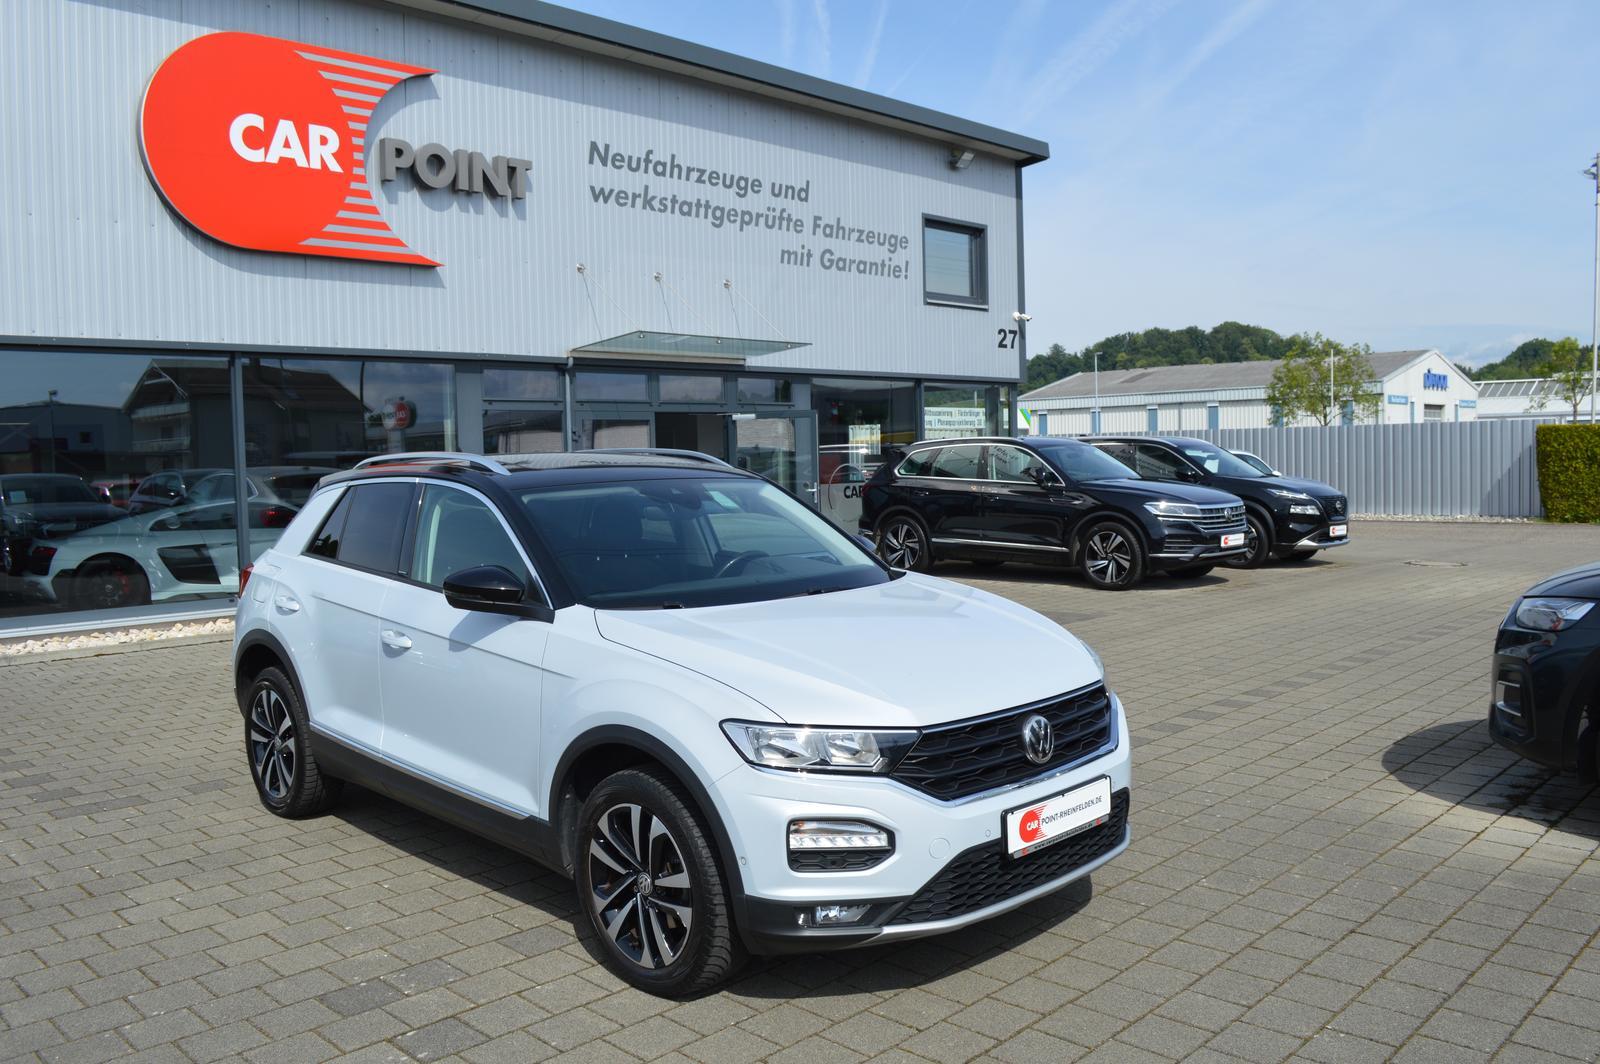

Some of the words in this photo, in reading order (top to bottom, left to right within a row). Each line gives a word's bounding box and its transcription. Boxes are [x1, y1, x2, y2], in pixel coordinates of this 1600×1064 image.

[229, 113, 343, 173] CAR
[380, 138, 532, 199] POINT
[588, 141, 763, 198] Neufahrzeuge
[771, 180, 811, 203] und
[589, 184, 804, 232] werkstattgeprüfte
[812, 215, 909, 253] Fahrzeuge
[780, 245, 813, 267] mit
[820, 249, 910, 280] Garantie!
[998, 329, 1018, 349] 27
[1026, 819, 1039, 831] CAR
[1041, 796, 1102, 826] POINT-RHEINFELDEN.DE
